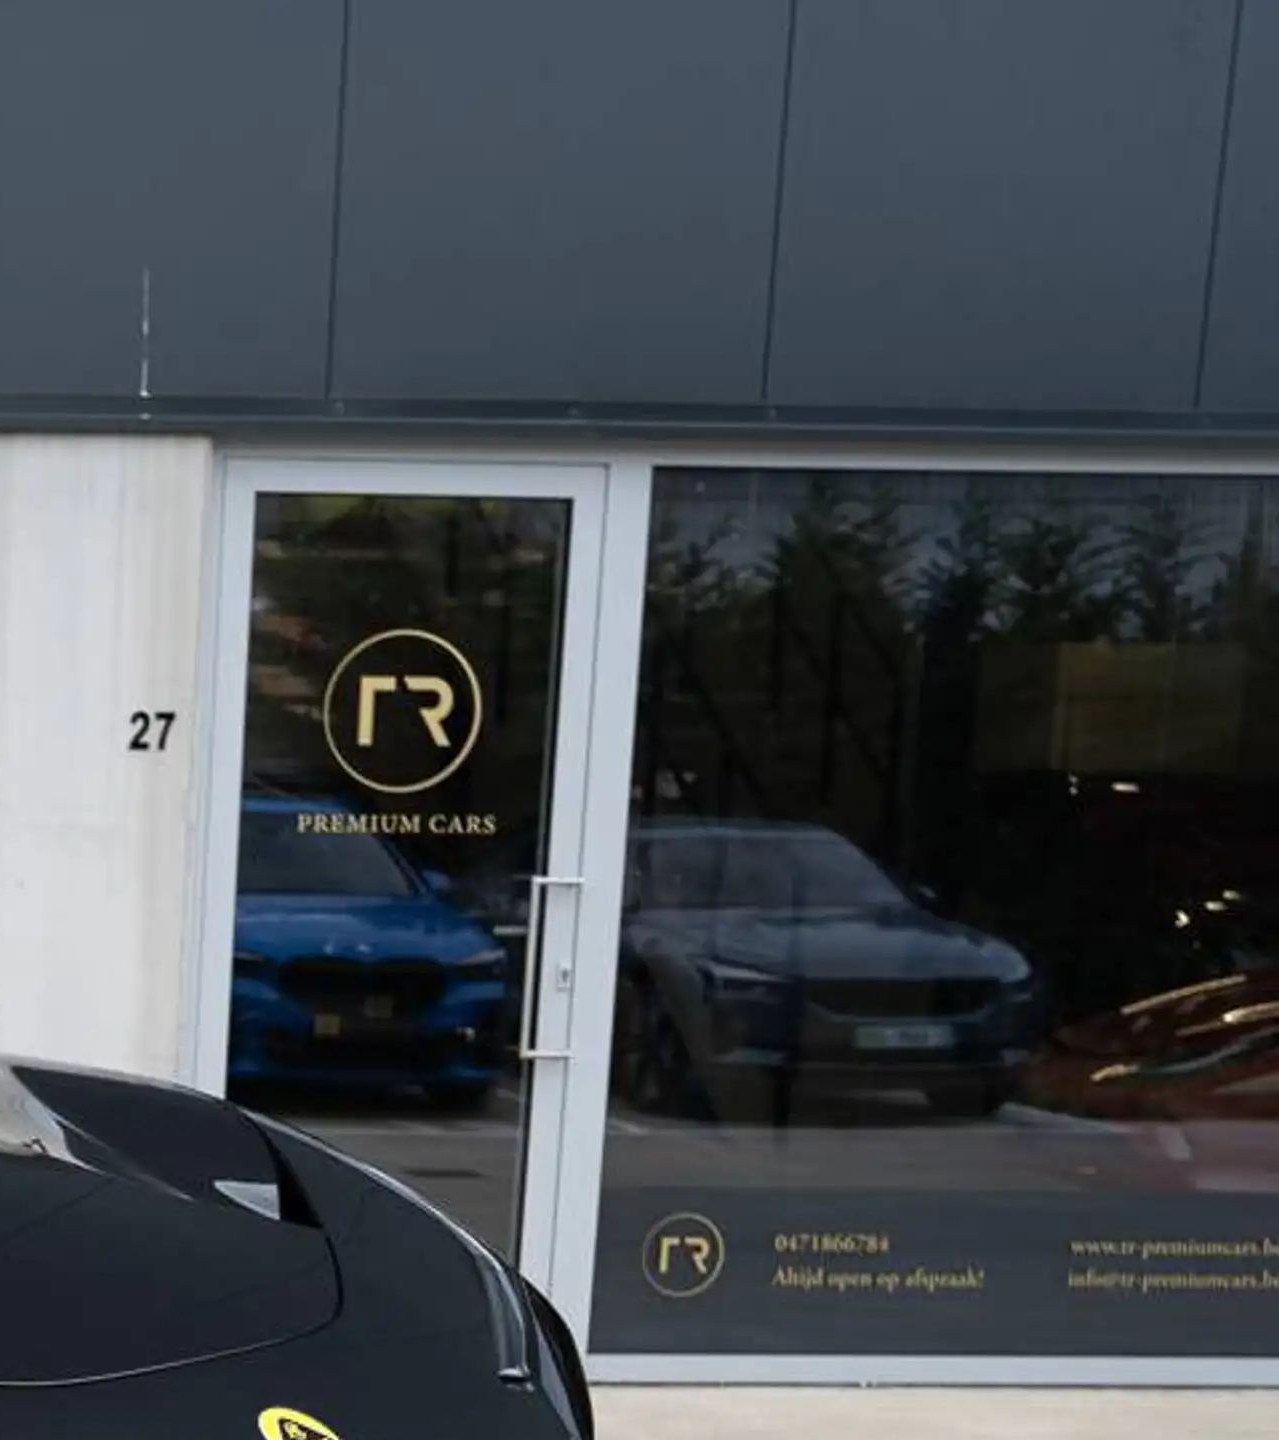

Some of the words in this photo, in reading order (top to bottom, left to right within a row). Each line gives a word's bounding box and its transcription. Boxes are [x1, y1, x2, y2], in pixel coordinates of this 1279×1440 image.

[129, 711, 176, 751] 27
[296, 813, 421, 835] PREMIUM
[429, 814, 497, 836] CARS
